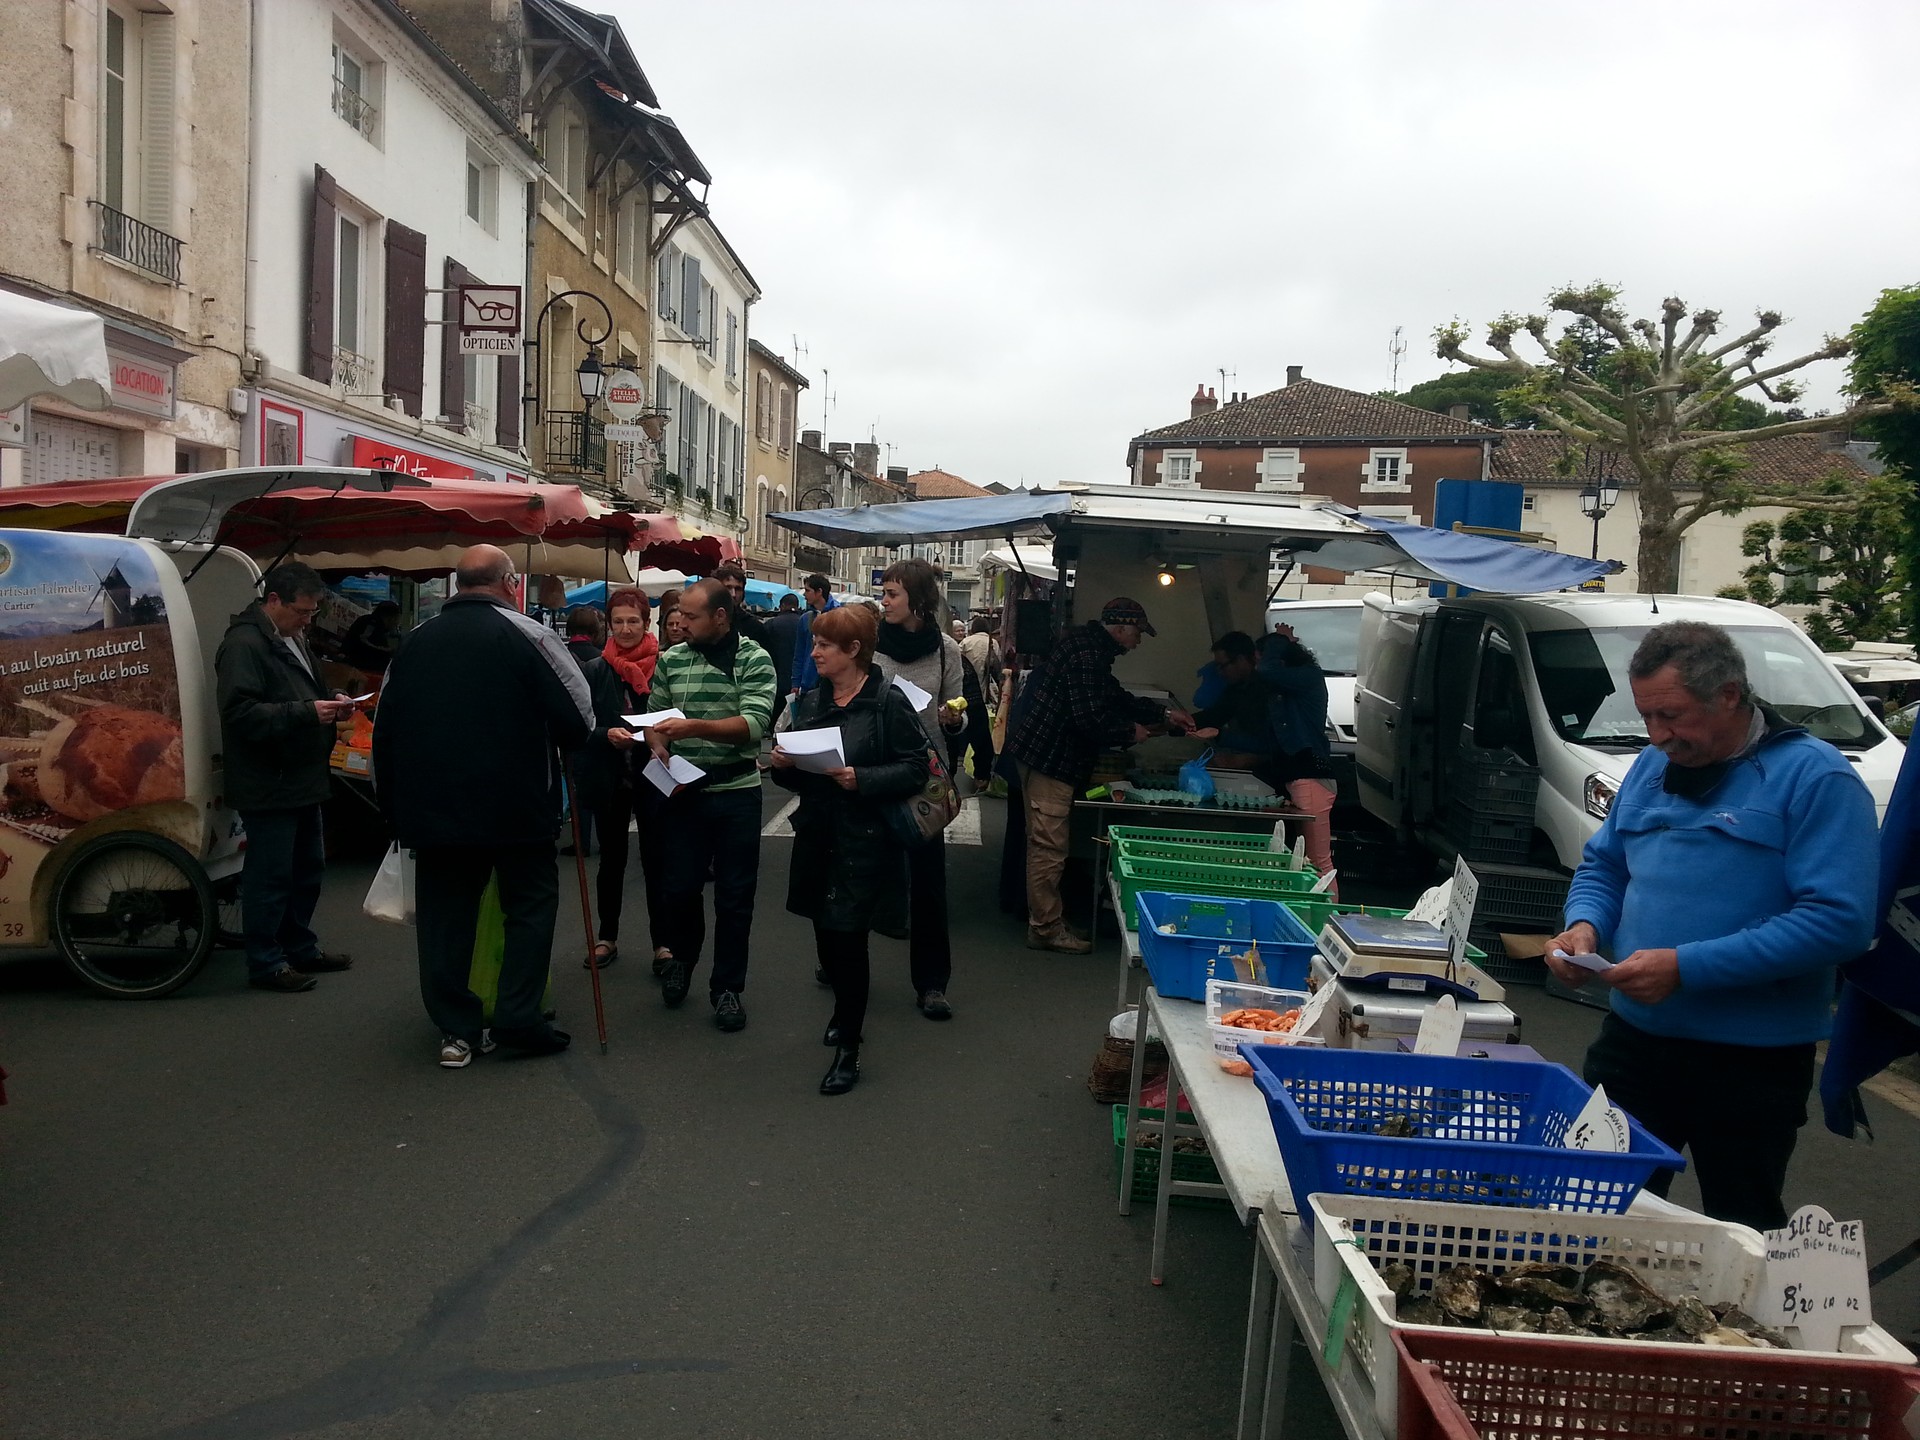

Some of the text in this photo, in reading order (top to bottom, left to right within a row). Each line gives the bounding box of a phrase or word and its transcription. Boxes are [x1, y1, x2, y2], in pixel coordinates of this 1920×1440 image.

[463, 337, 515, 351] OPTICIEN
[115, 363, 164, 397] LOCATION
[41, 579, 94, 595] Talmelier
[4, 601, 35, 611] Cartier
[10, 660, 31, 674] au
[34, 649, 82, 669] levain
[85, 632, 147, 659] naturel
[23, 660, 150, 695] cuit au feu de bois
[3, 922, 24, 937] 38
[1788, 1213, 1813, 1241] ILE
[1817, 1219, 1835, 1237] DE
[1823, 1296, 1835, 1309] LA
